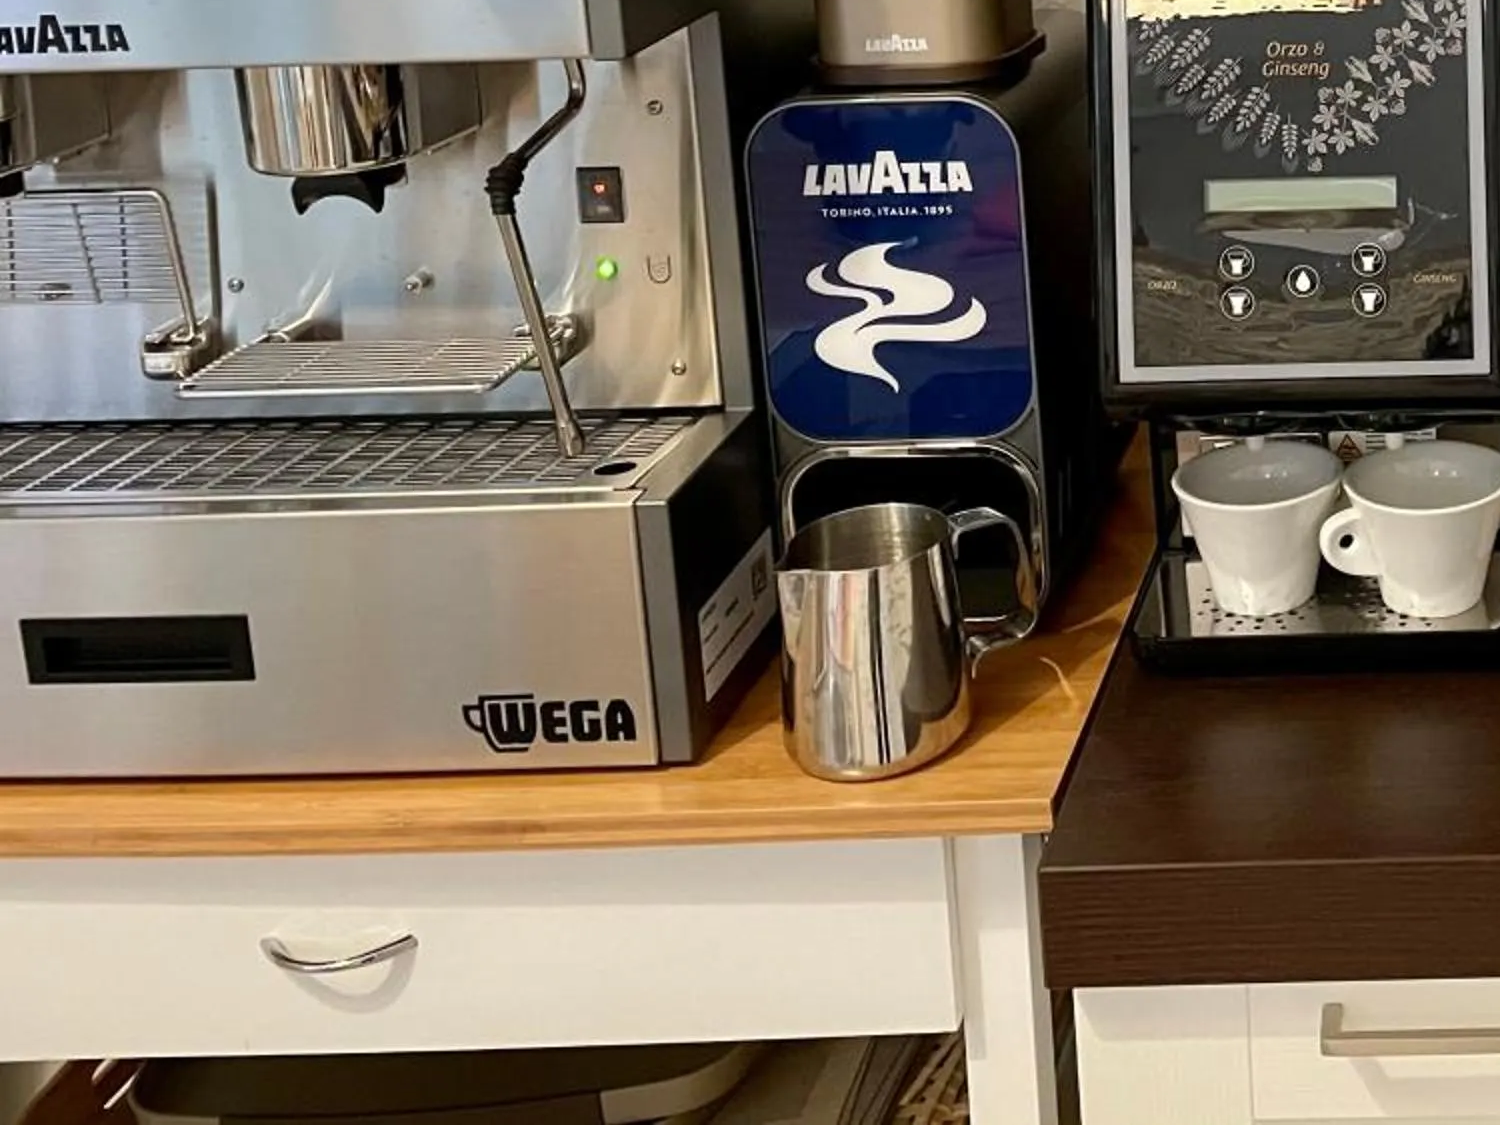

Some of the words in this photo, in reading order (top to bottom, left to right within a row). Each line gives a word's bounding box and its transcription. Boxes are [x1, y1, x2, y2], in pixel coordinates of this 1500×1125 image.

[0, 14, 130, 53] AVAZZA
[864, 34, 928, 52] LAVAZZA
[1267, 40, 1308, 57] Orzo
[1262, 60, 1329, 80] Ginseng
[803, 150, 974, 196] LAVAZZA
[924, 205, 953, 215] 1895
[488, 699, 637, 744] WEGA
